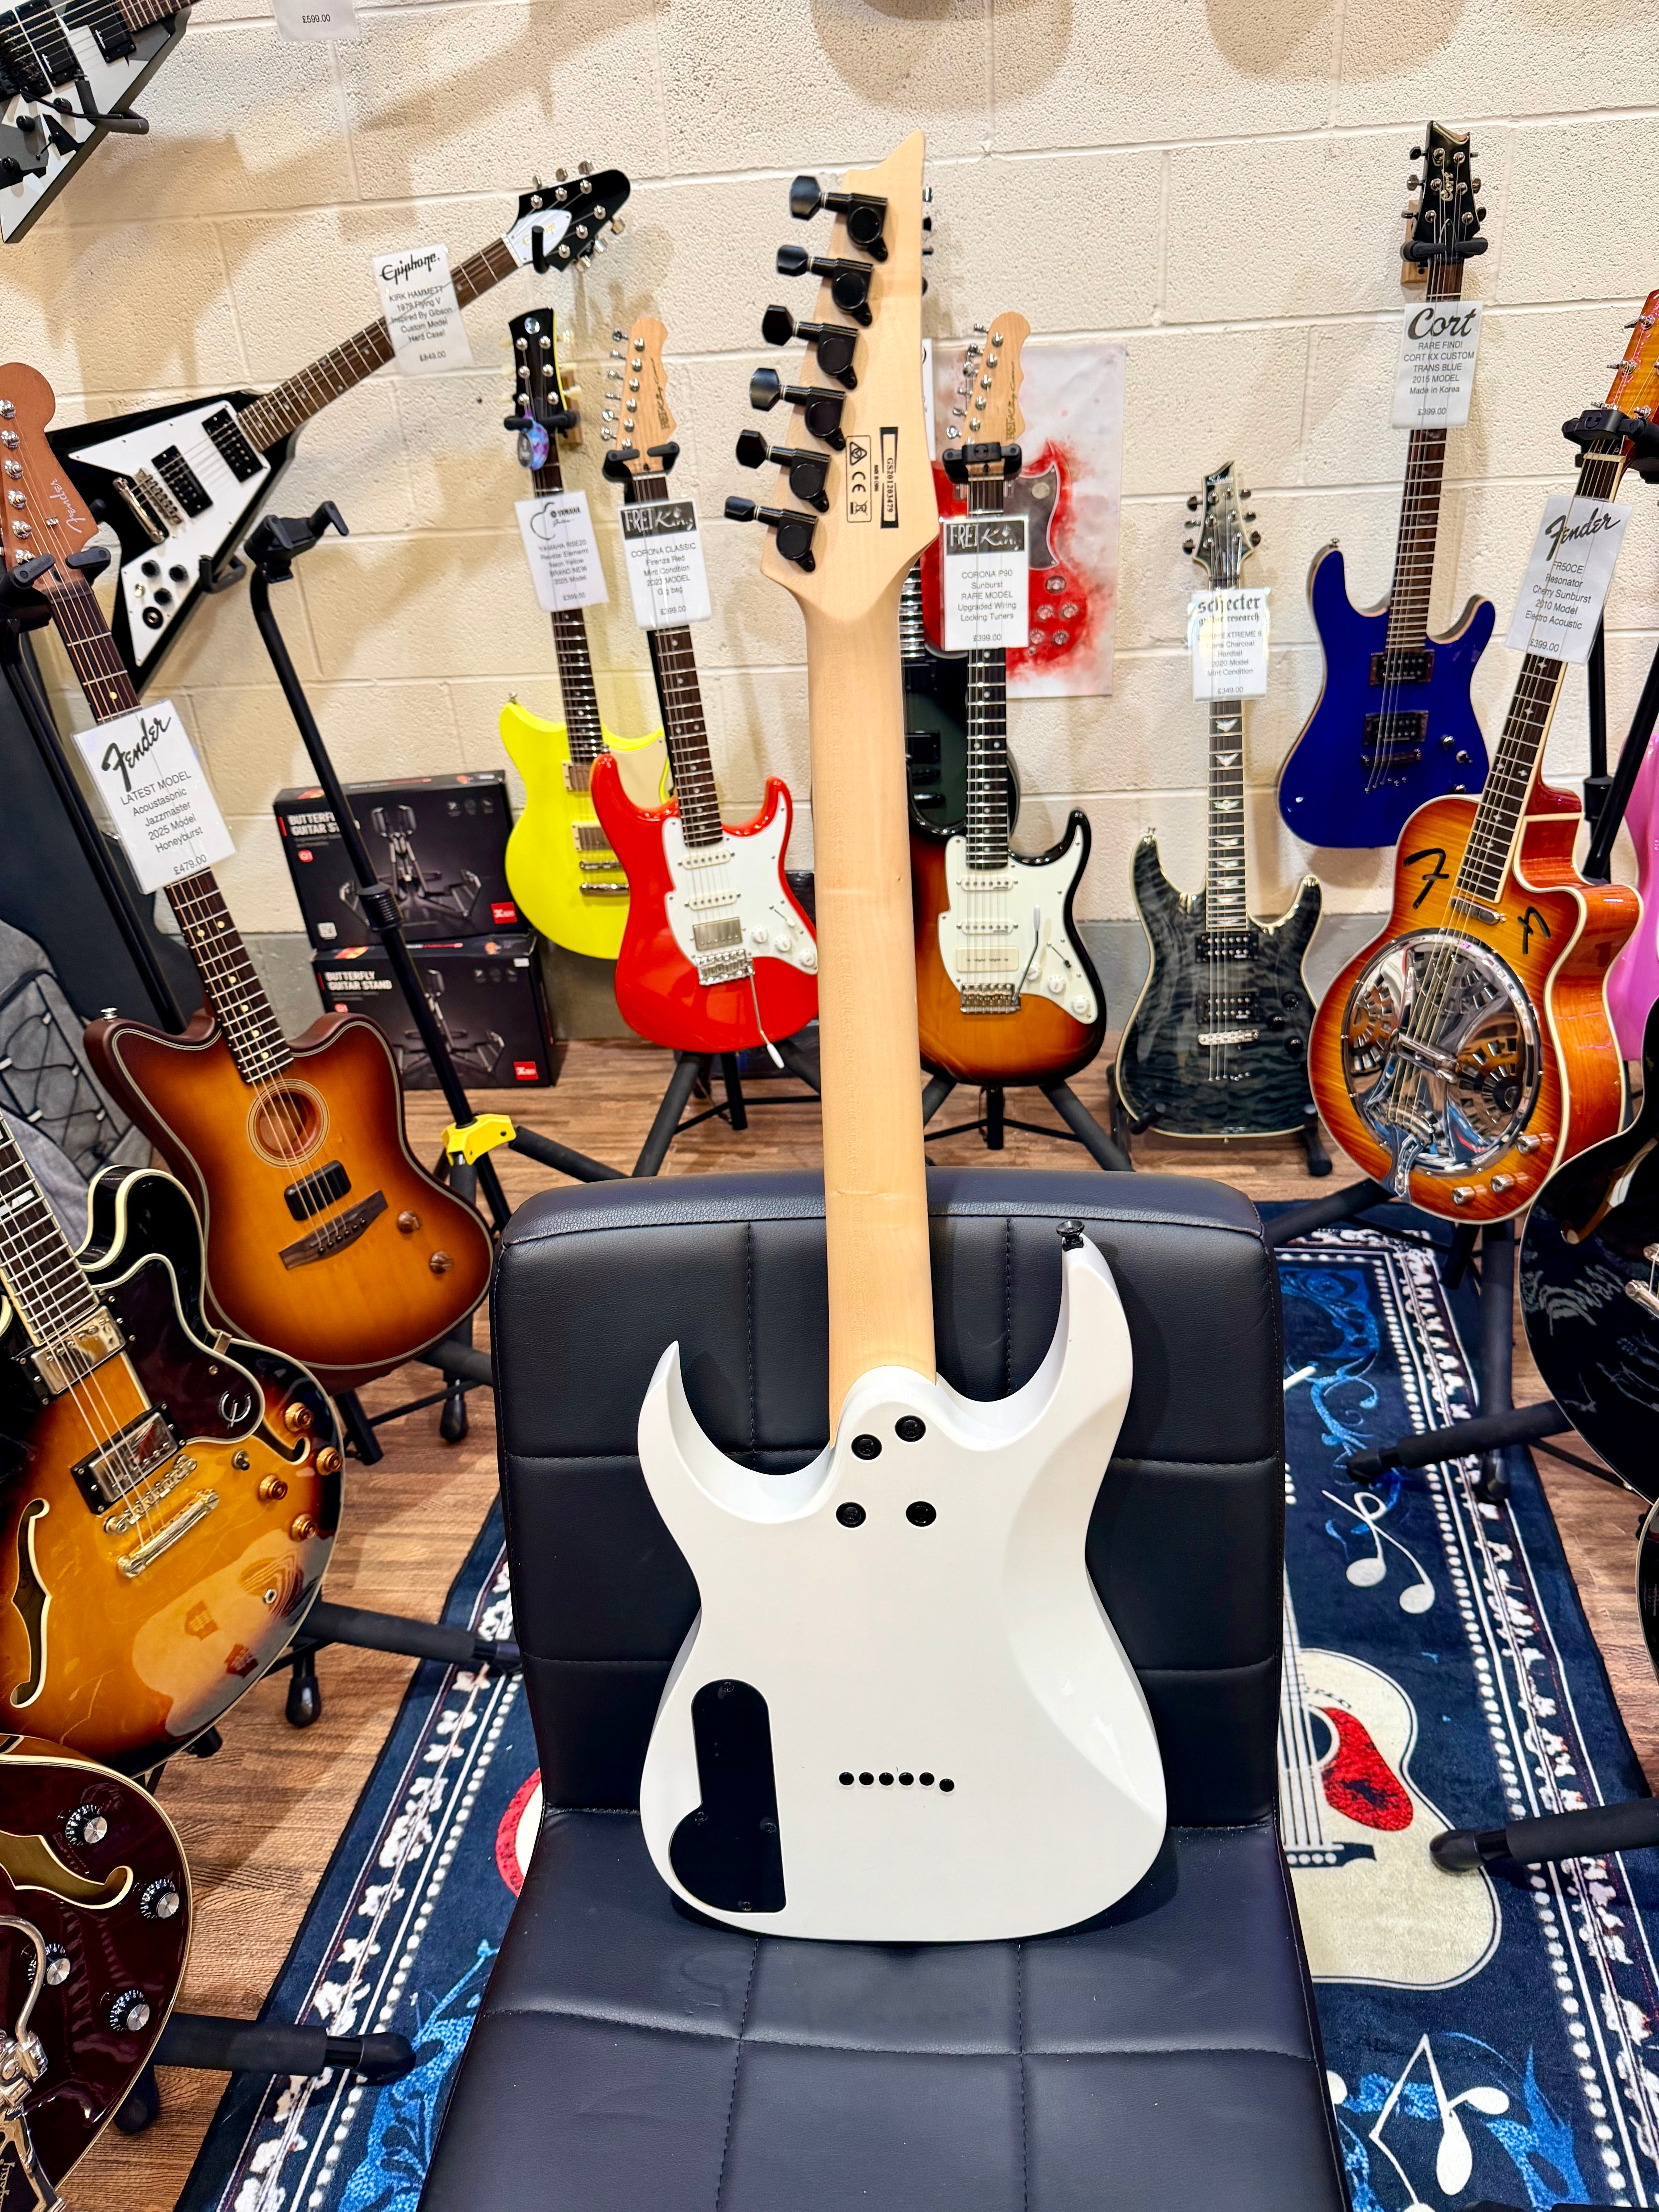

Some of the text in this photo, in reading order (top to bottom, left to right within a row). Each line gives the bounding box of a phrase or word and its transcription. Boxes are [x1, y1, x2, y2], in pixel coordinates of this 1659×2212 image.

[302, 14, 331, 23] £599.00
[389, 292, 407, 302] KIRK
[419, 311, 428, 320] By
[429, 307, 453, 317] Gibson
[400, 318, 448, 333] Custom Model
[1407, 307, 1477, 340] Cort
[408, 334, 425, 343] Hard
[1418, 340, 1463, 349] RARE FIND!
[1403, 351, 1474, 362] CORT KX CUSTOM
[1414, 362, 1462, 372] TRANS BLUE
[1412, 374, 1459, 383] 2015 MODEL
[1417, 407, 1446, 416] £399.00
[1545, 508, 1621, 562] Fender
[631, 543, 696, 558] CORONA CLASSIC
[659, 565, 689, 574] Condition
[961, 570, 996, 579] CORONA
[665, 574, 690, 583] MODEL
[1545, 573, 1583, 587] Resonator
[985, 591, 1012, 599] MODEL
[1532, 584, 1591, 603] Cherry Sunburst
[958, 601, 1016, 612] Upgraded Wiring
[1535, 599, 1578, 614] 2010 Model
[960, 613, 987, 622] Locking
[1525, 610, 1582, 629] Electro Acoustic
[973, 634, 1001, 642] £399.00
[1221, 630, 1255, 639] EXTREME
[1529, 638, 1559, 652] £399.00
[101, 716, 172, 792] Fender
[120, 771, 191, 805] LATEST MODEL
[133, 788, 186, 816] Acoustasonic
[145, 802, 190, 826] Jazzmaster
[148, 813, 196, 840] 2025 Model
[290, 823, 327, 836] GUITAR
[155, 826, 203, 852] Honeyburst
[173, 854, 206, 875] £479.00
[324, 970, 375, 981] BUTTERFLY
[327, 979, 392, 991] GUITAR STAND
